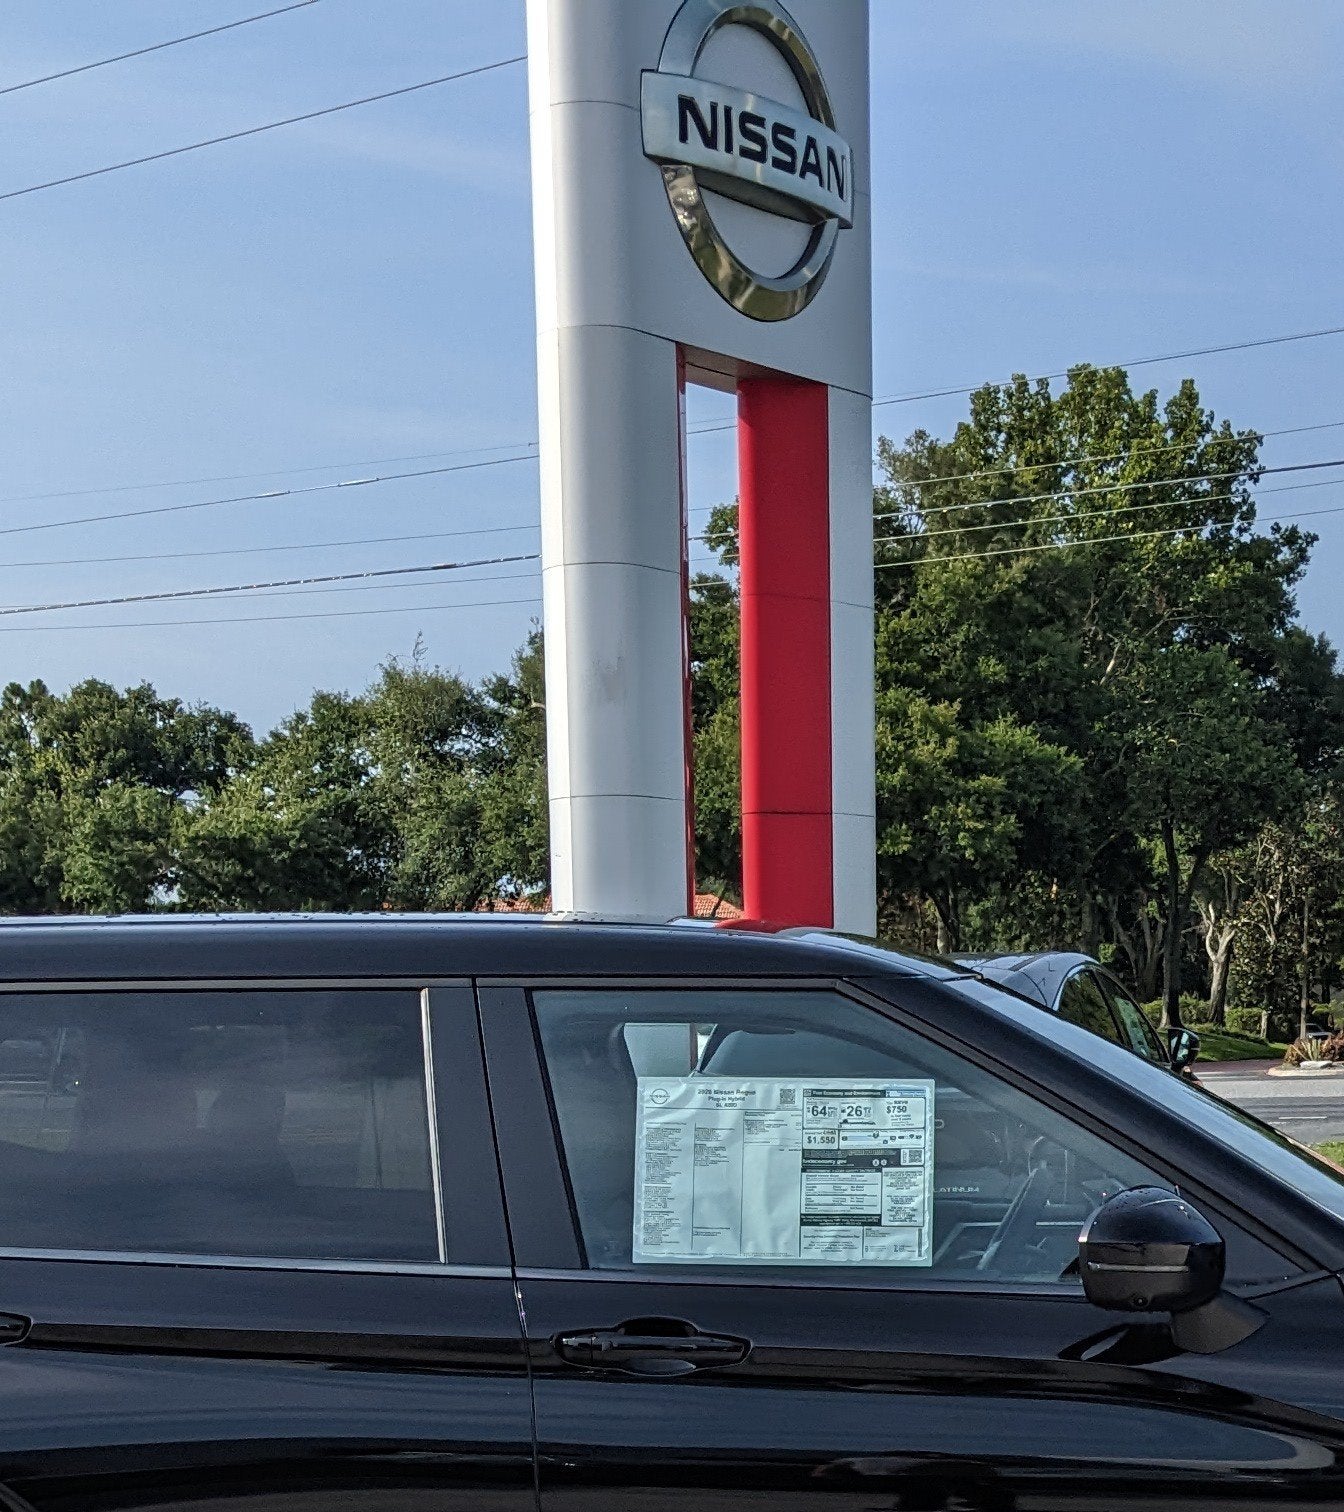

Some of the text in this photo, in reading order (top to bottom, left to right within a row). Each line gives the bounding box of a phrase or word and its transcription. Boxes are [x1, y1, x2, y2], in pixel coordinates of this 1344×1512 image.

[678, 94, 846, 202] NISSAN
[811, 1105, 828, 1117] 64
[846, 1105, 863, 1117] 26
[886, 1105, 908, 1114] $750
[807, 1135, 836, 1145] $1,550
